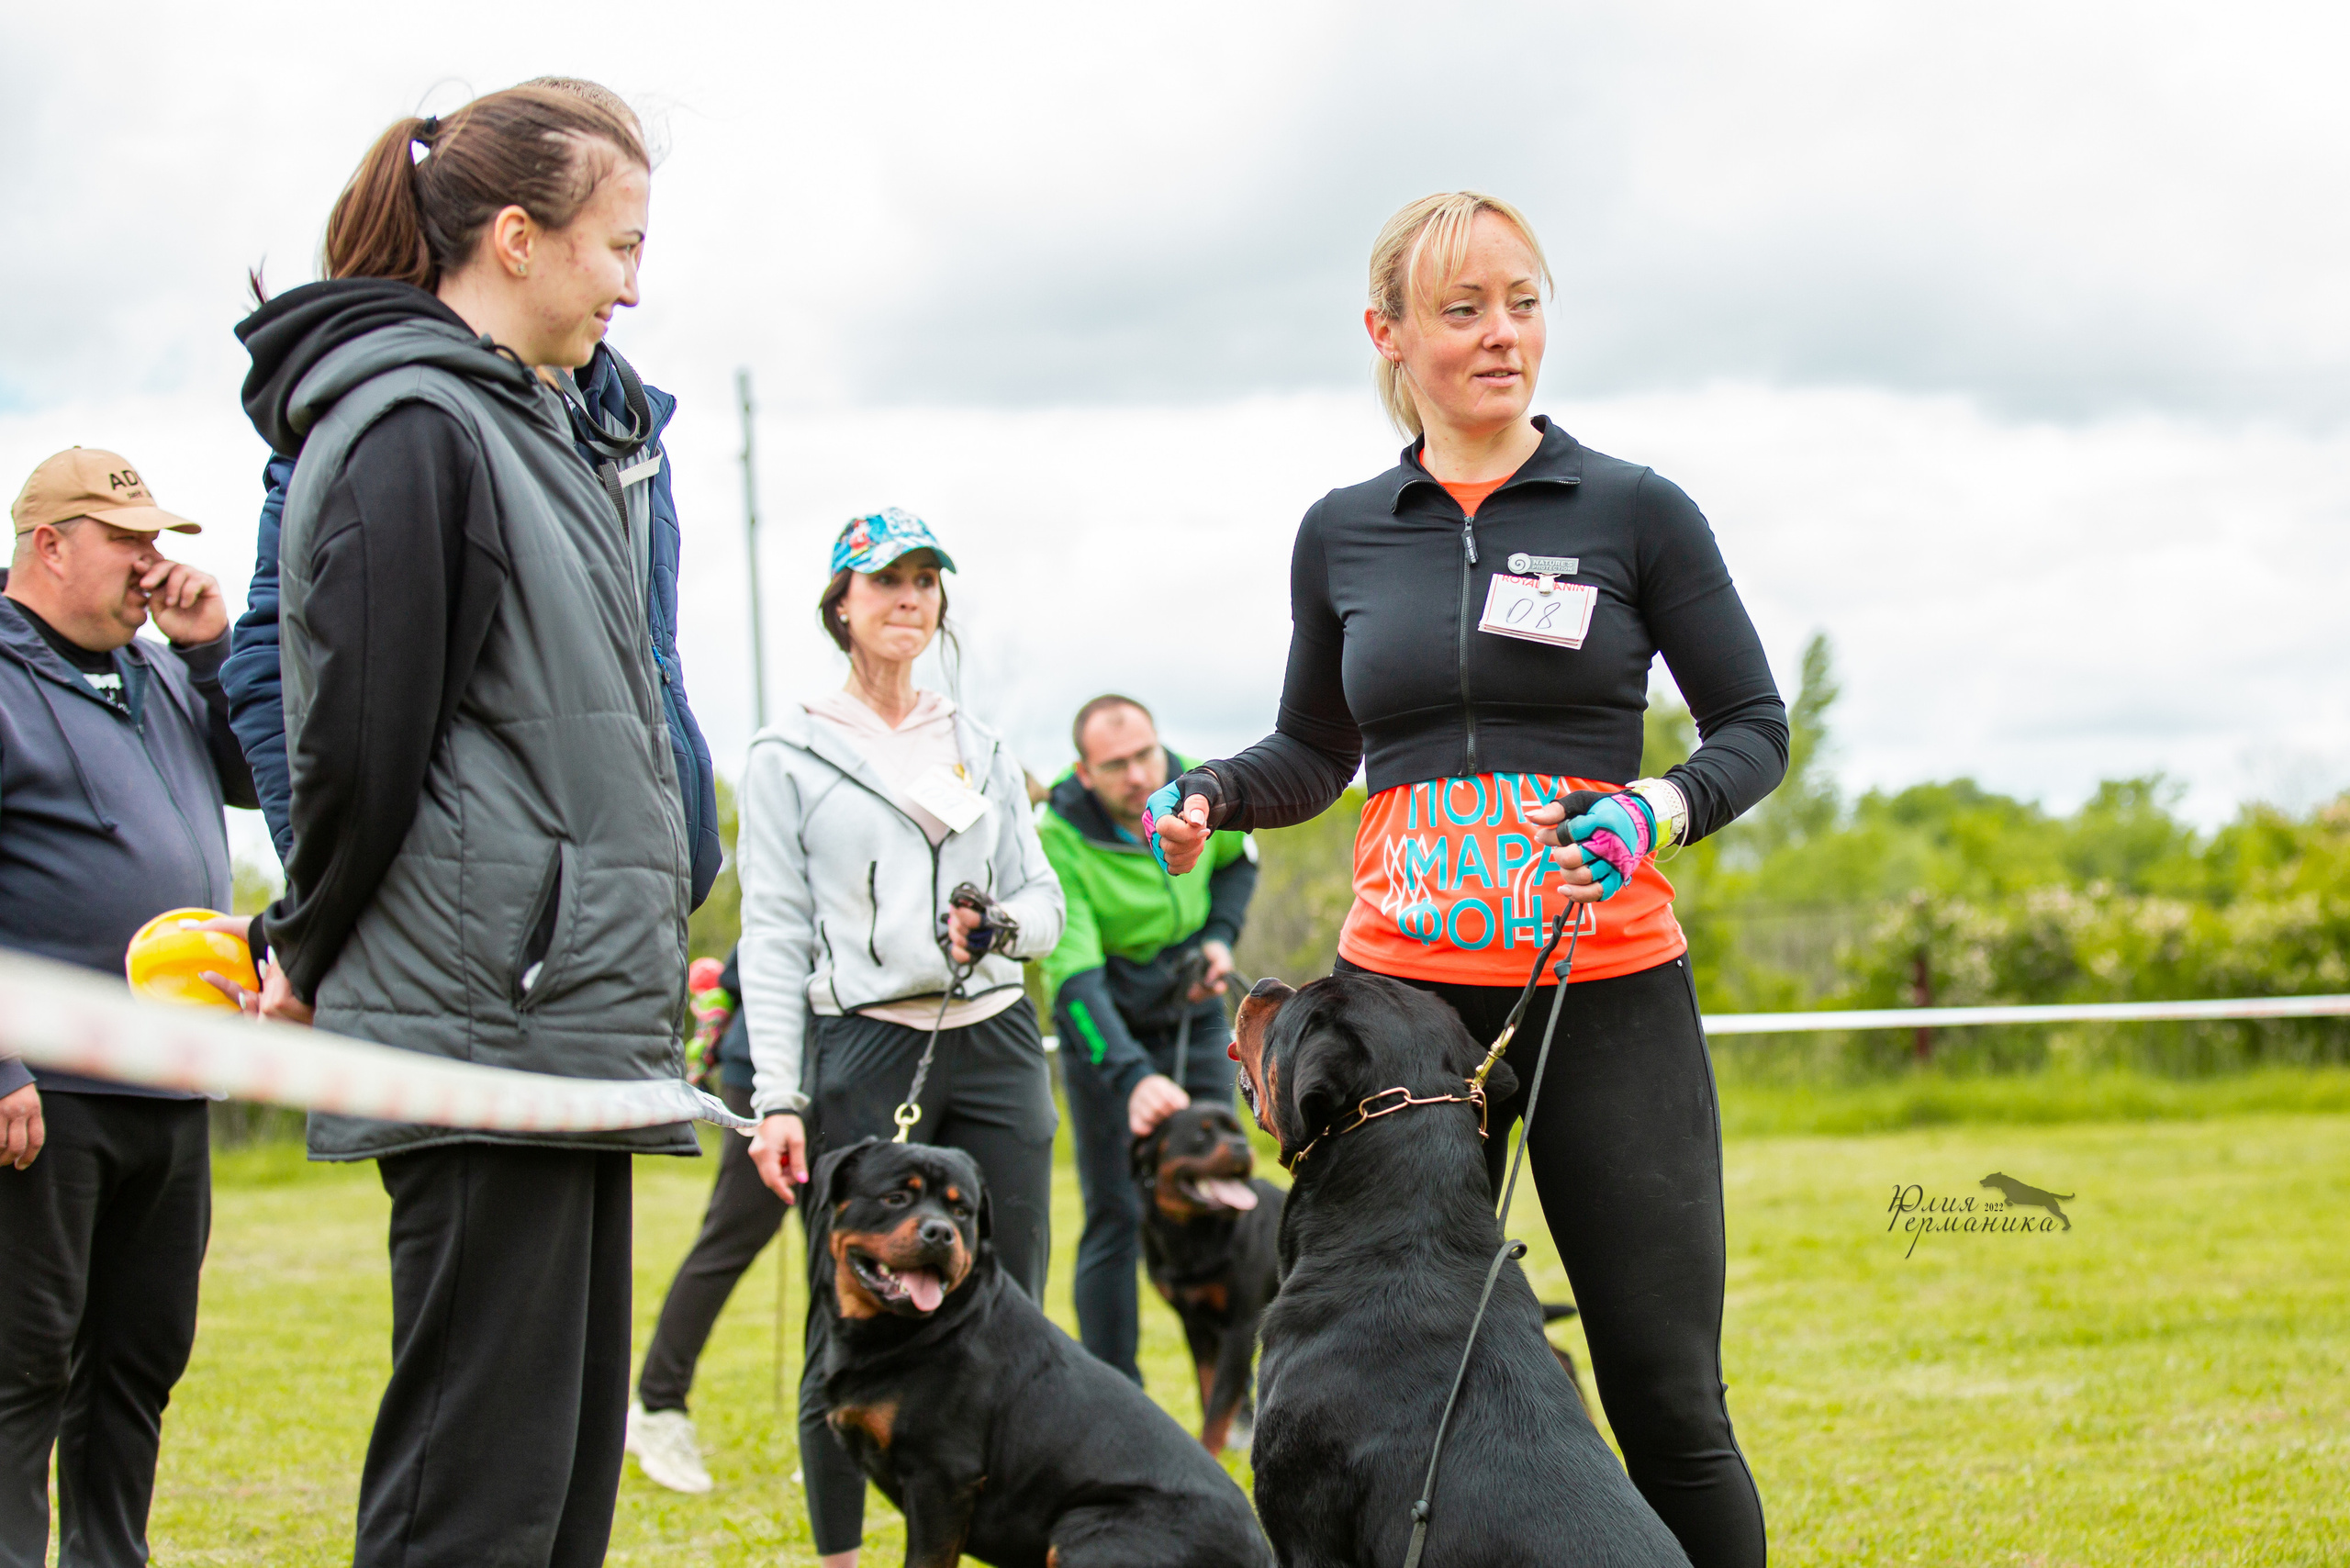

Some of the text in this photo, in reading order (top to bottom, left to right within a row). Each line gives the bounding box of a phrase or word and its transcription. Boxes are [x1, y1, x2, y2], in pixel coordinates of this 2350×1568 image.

[1533, 559, 1573, 567] NATURE'S
[1552, 581, 1585, 592] ANIN
[1505, 599, 1561, 629] 08
[1398, 895, 1544, 951] ФОН
